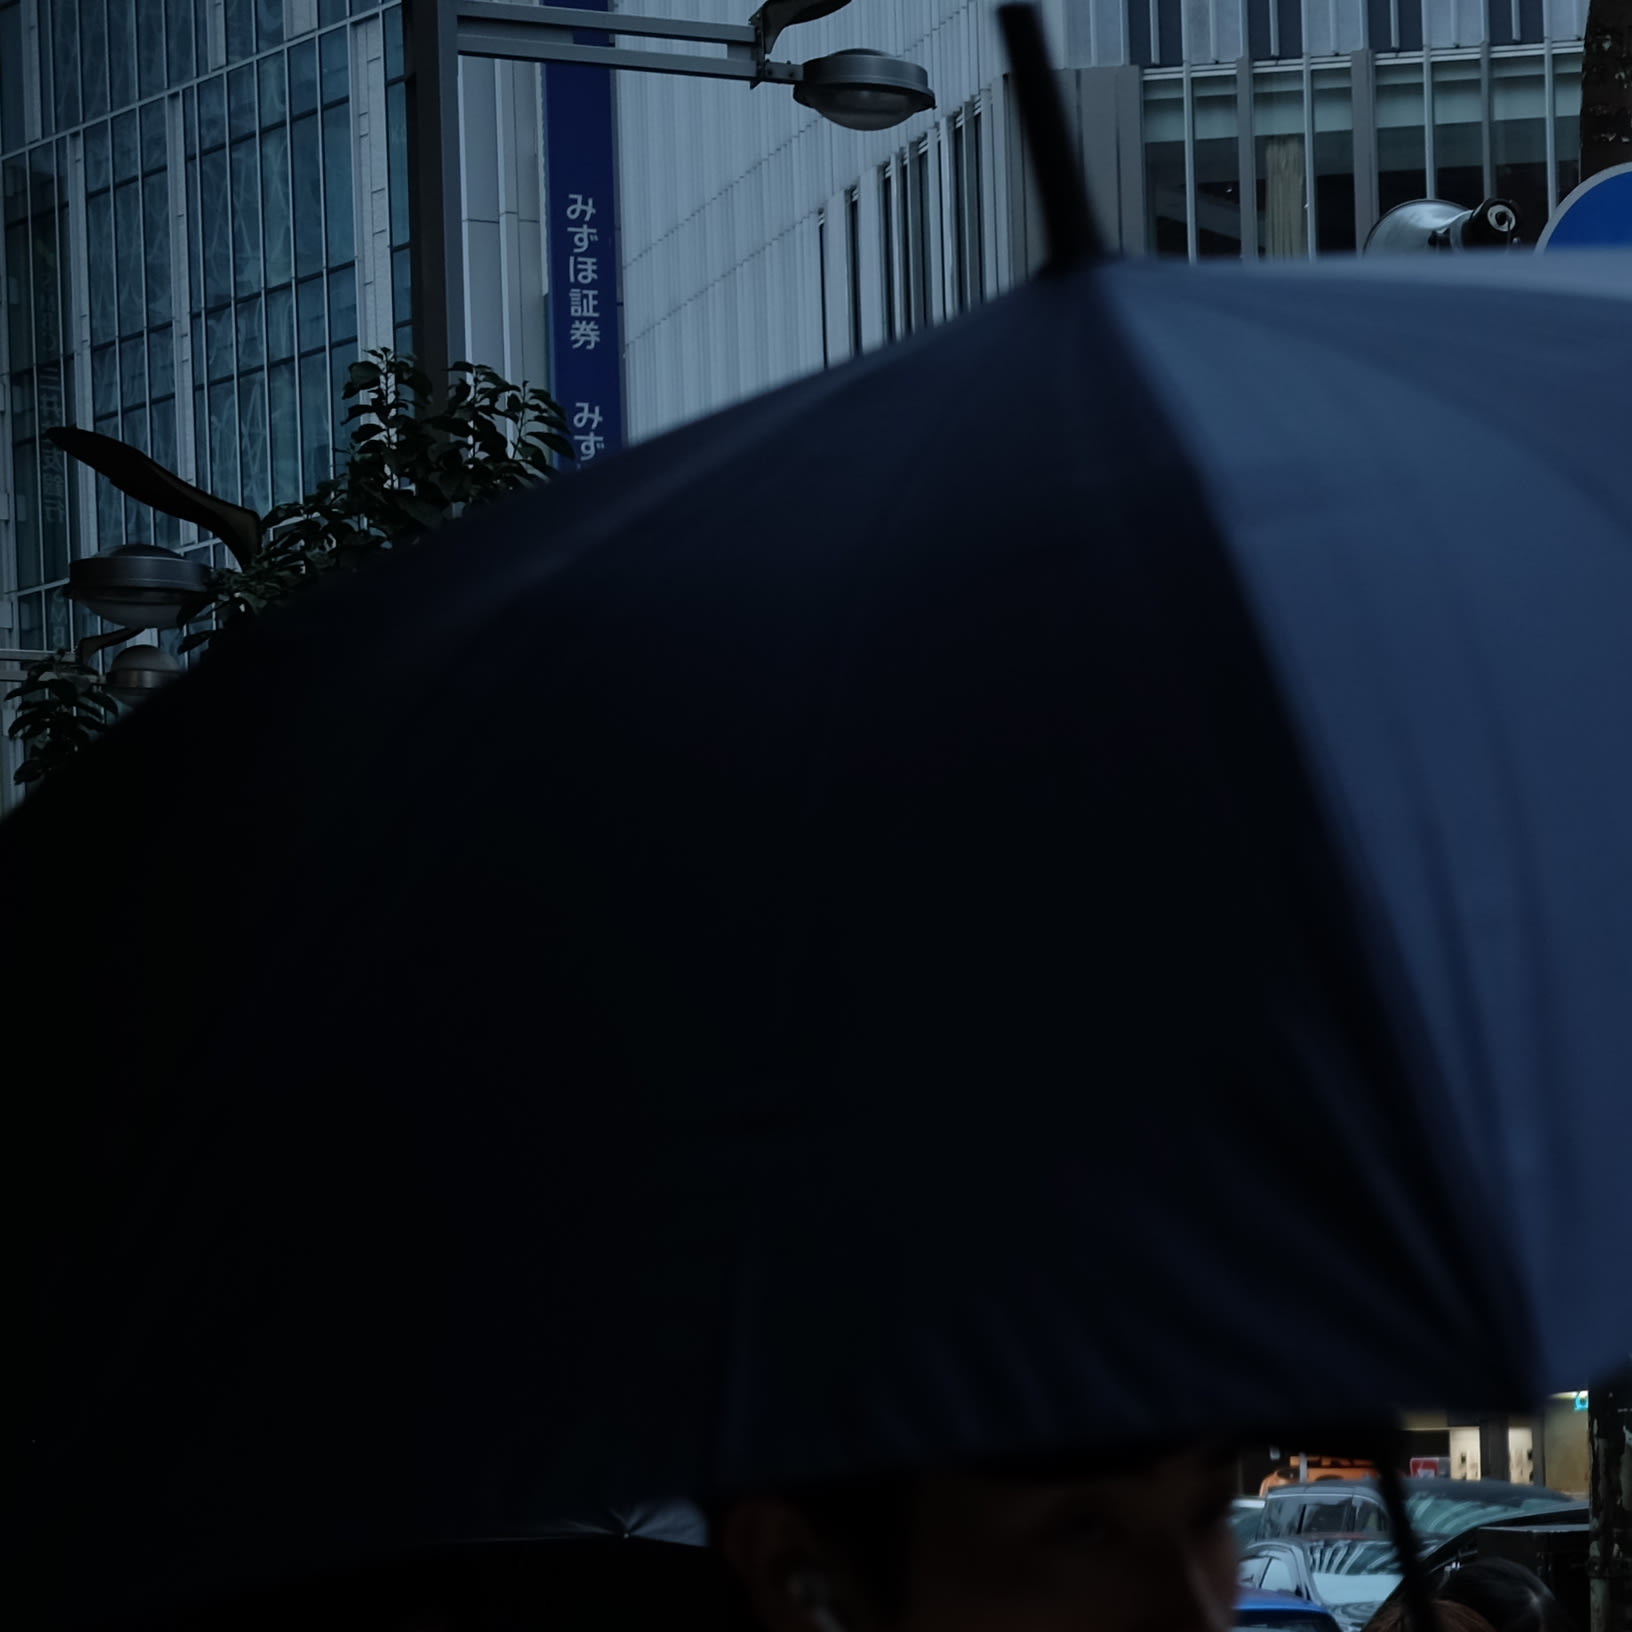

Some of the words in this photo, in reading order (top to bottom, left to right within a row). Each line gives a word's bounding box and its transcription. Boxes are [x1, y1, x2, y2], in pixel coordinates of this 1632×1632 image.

[566, 193, 600, 350] みずほ証券
[572, 401, 605, 470] みず
